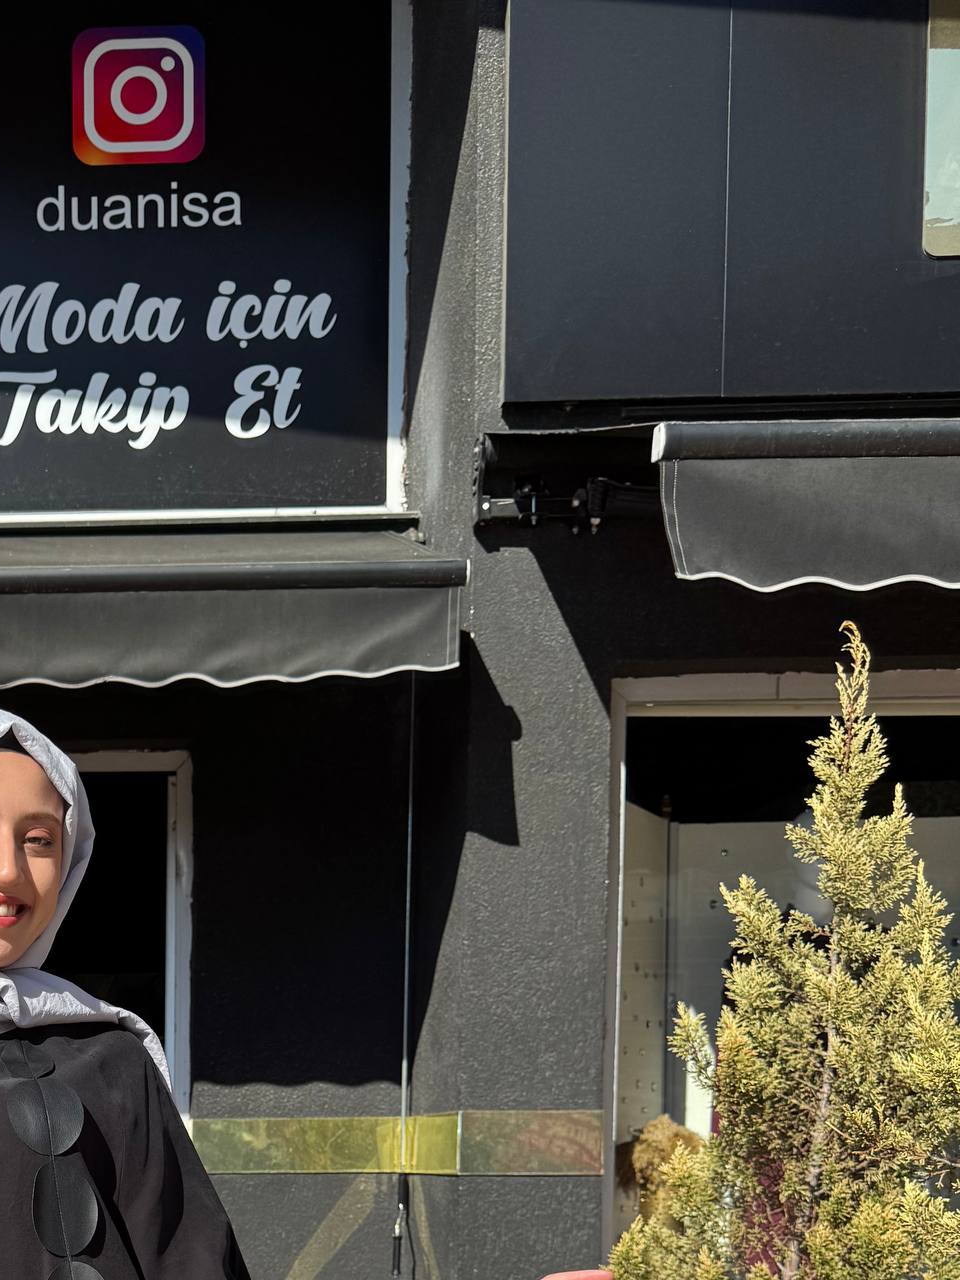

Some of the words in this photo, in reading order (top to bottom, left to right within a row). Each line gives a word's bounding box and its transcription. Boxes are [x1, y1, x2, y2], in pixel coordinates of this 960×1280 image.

[36, 181, 242, 232] duanisa
[206, 279, 338, 349] için
[225, 364, 304, 439] Et
